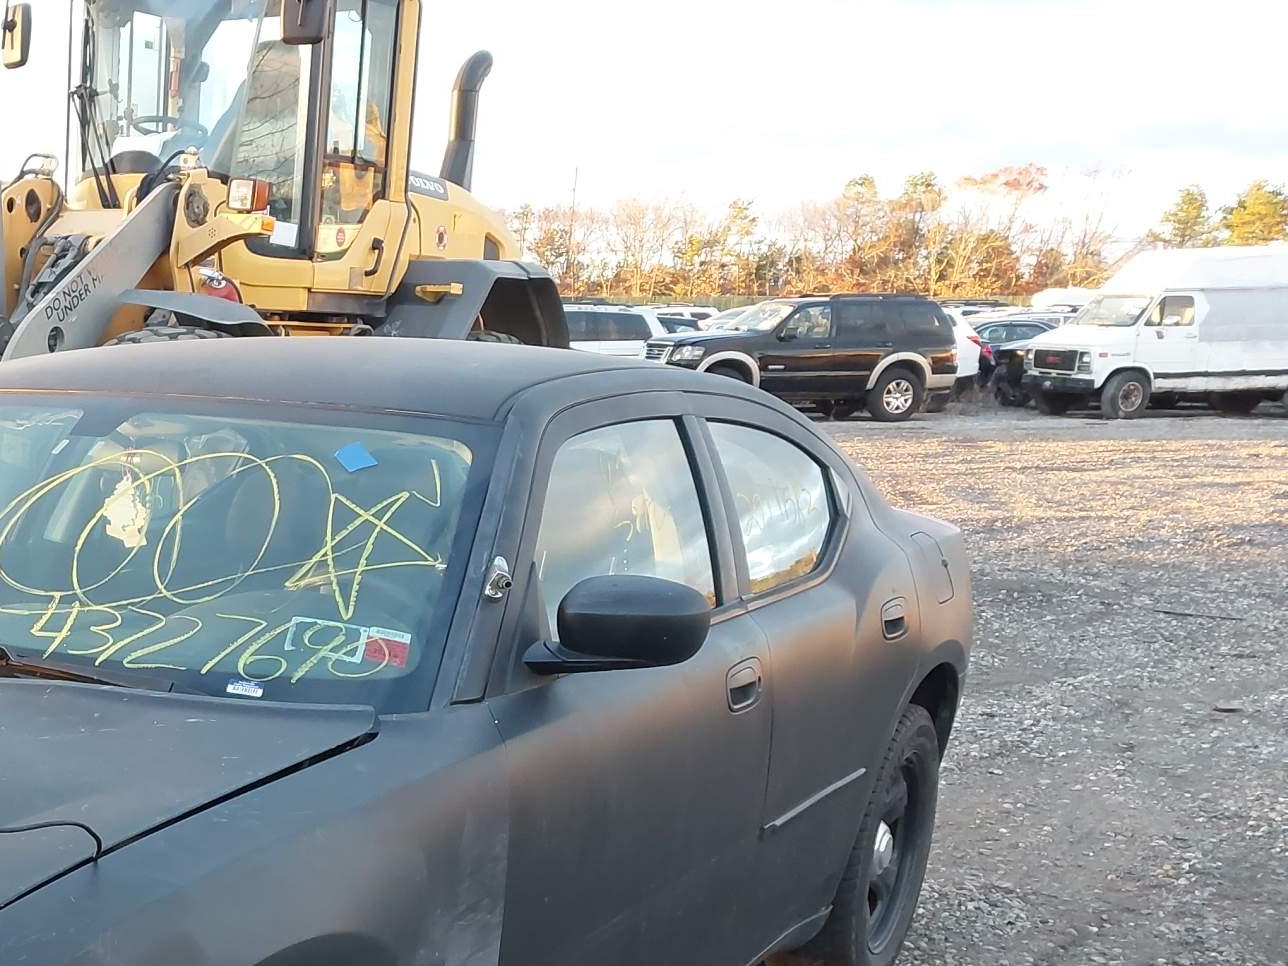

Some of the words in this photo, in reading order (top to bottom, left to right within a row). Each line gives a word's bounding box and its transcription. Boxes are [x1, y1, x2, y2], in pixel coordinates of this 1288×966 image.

[44, 297, 62, 321] DO
[62, 272, 85, 302] NOT
[56, 283, 92, 322] UNDER
[30, 592, 389, 684] 43727690
